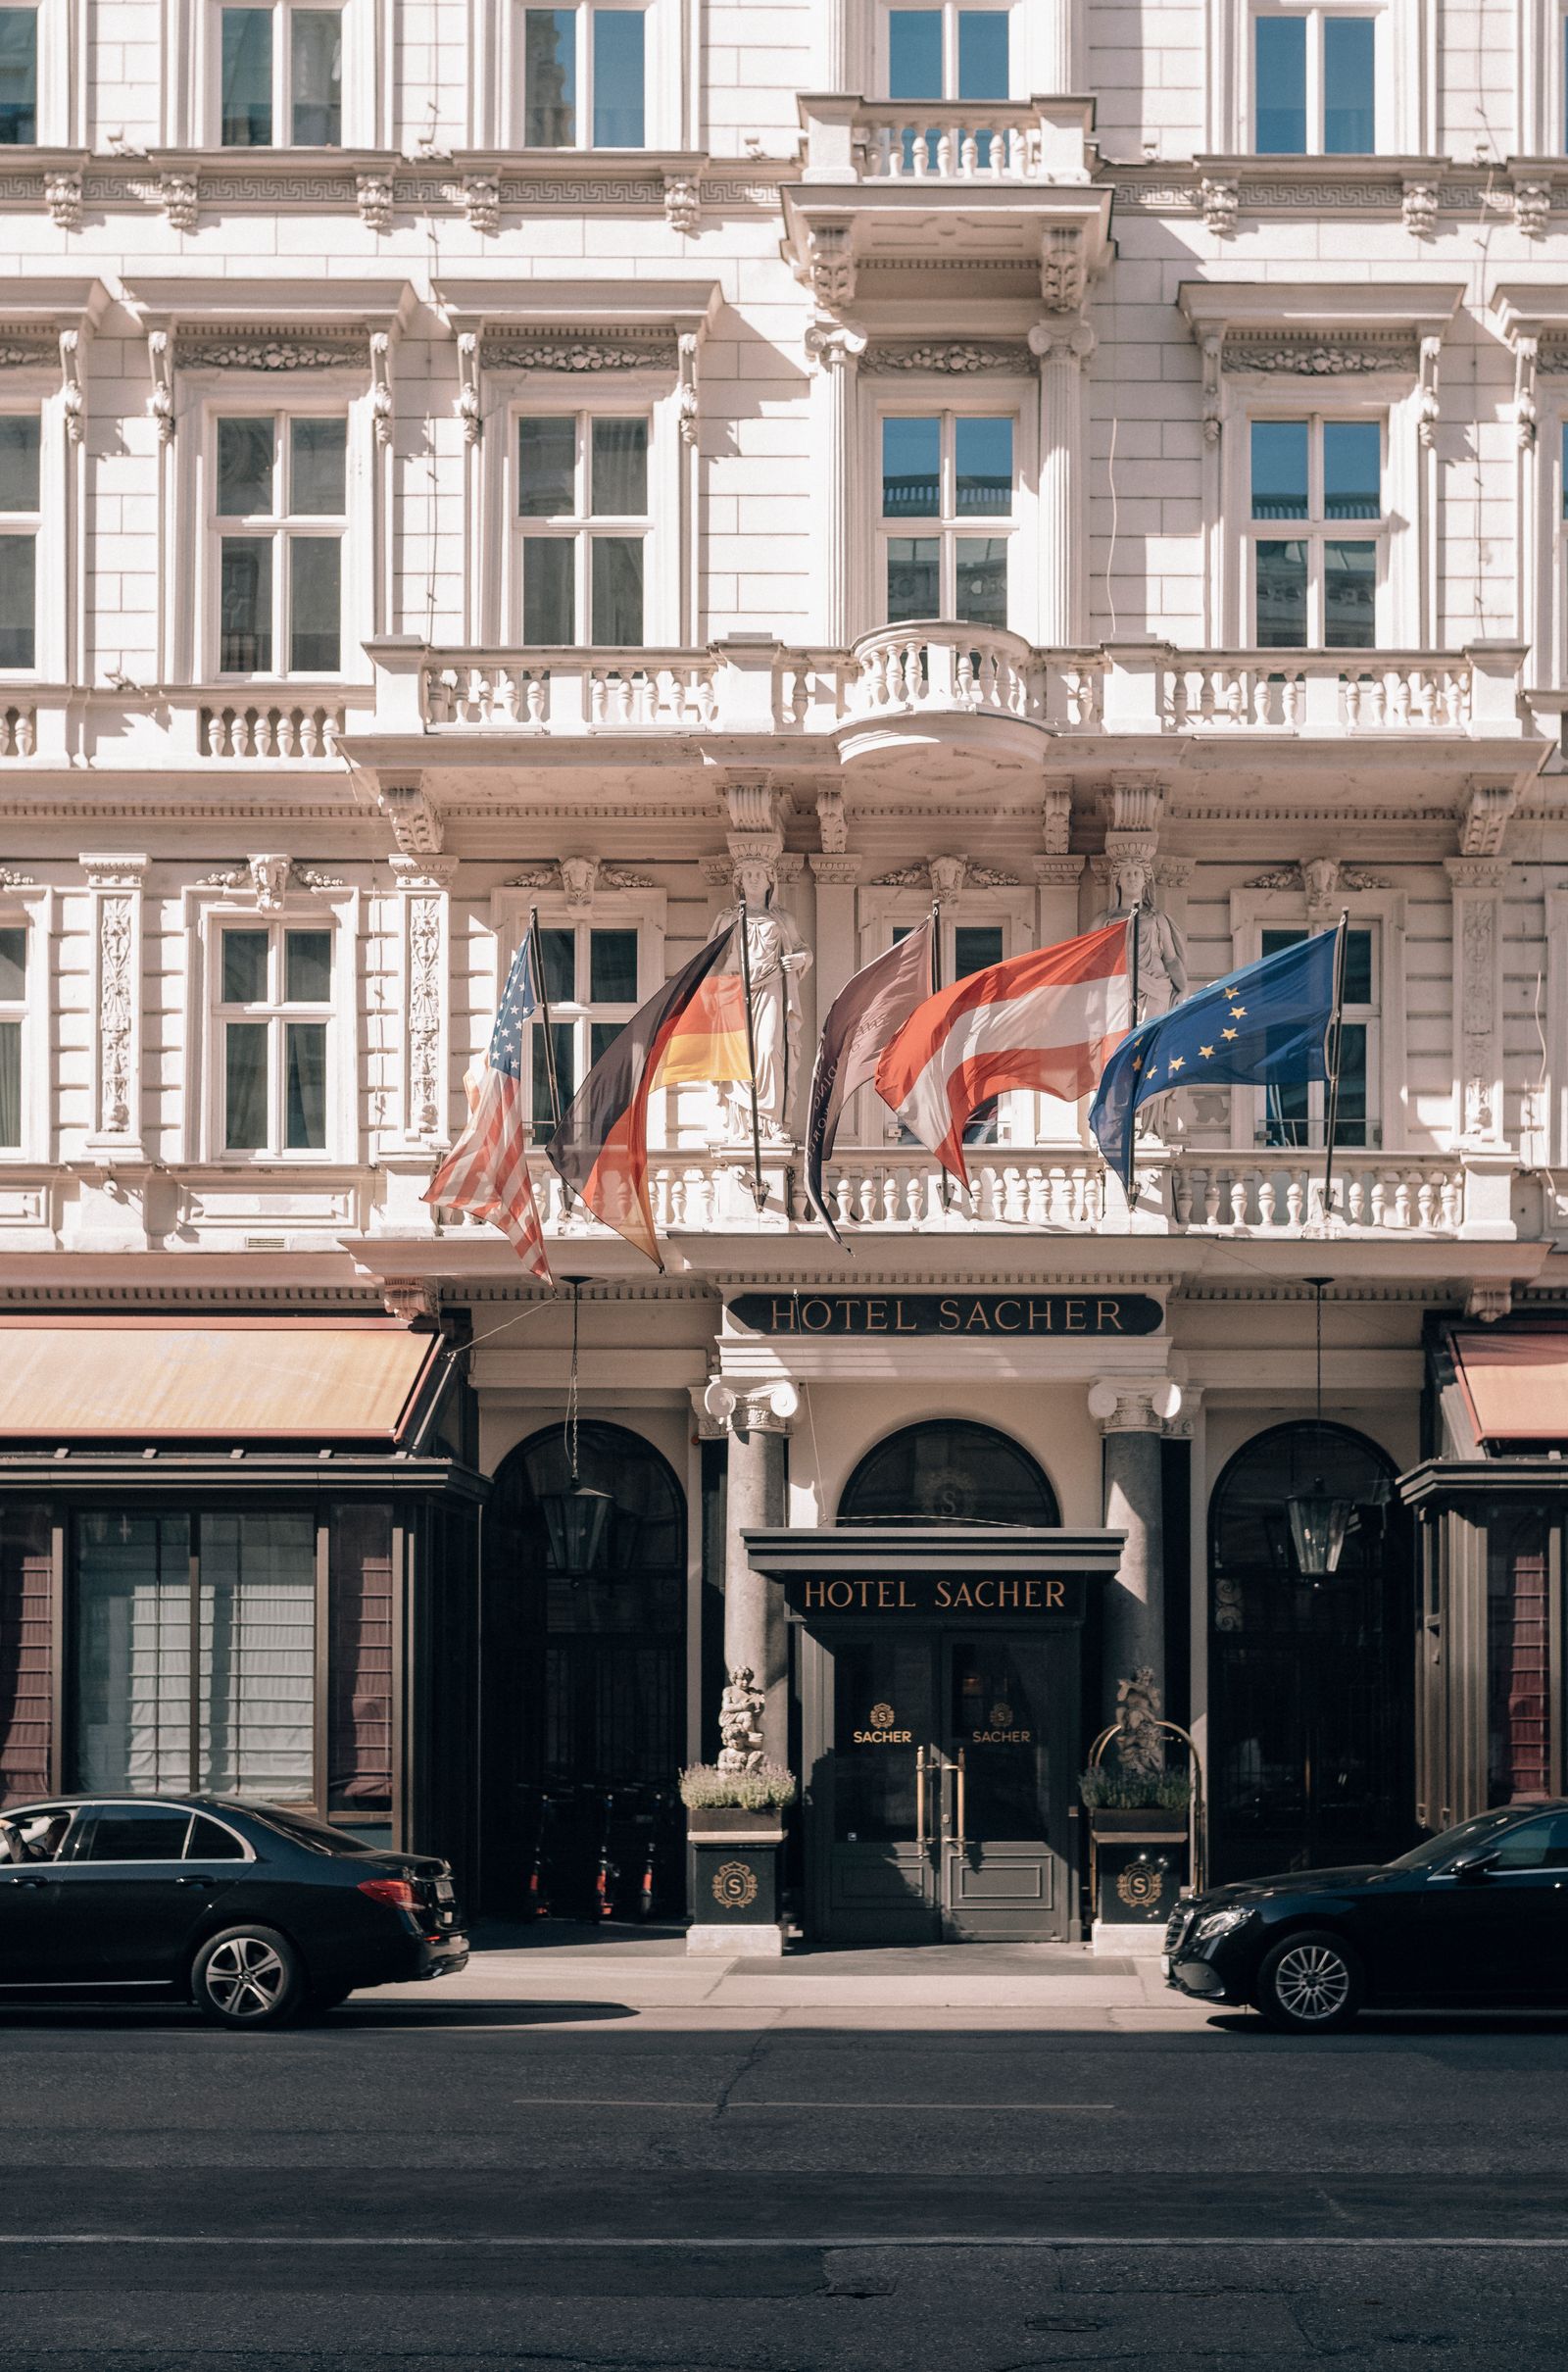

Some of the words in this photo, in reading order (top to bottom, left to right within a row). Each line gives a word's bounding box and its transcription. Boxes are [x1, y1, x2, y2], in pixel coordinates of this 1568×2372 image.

[771, 1300, 917, 1330] HOTEL
[939, 1300, 1123, 1330] SACHER
[806, 1581, 916, 1607] HOTEL
[935, 1581, 1065, 1607] SACHER
[853, 1731, 912, 1744] SACHER
[972, 1731, 1031, 1743] SACHER
[728, 1878, 742, 1895] S
[1133, 1877, 1146, 1894] S
